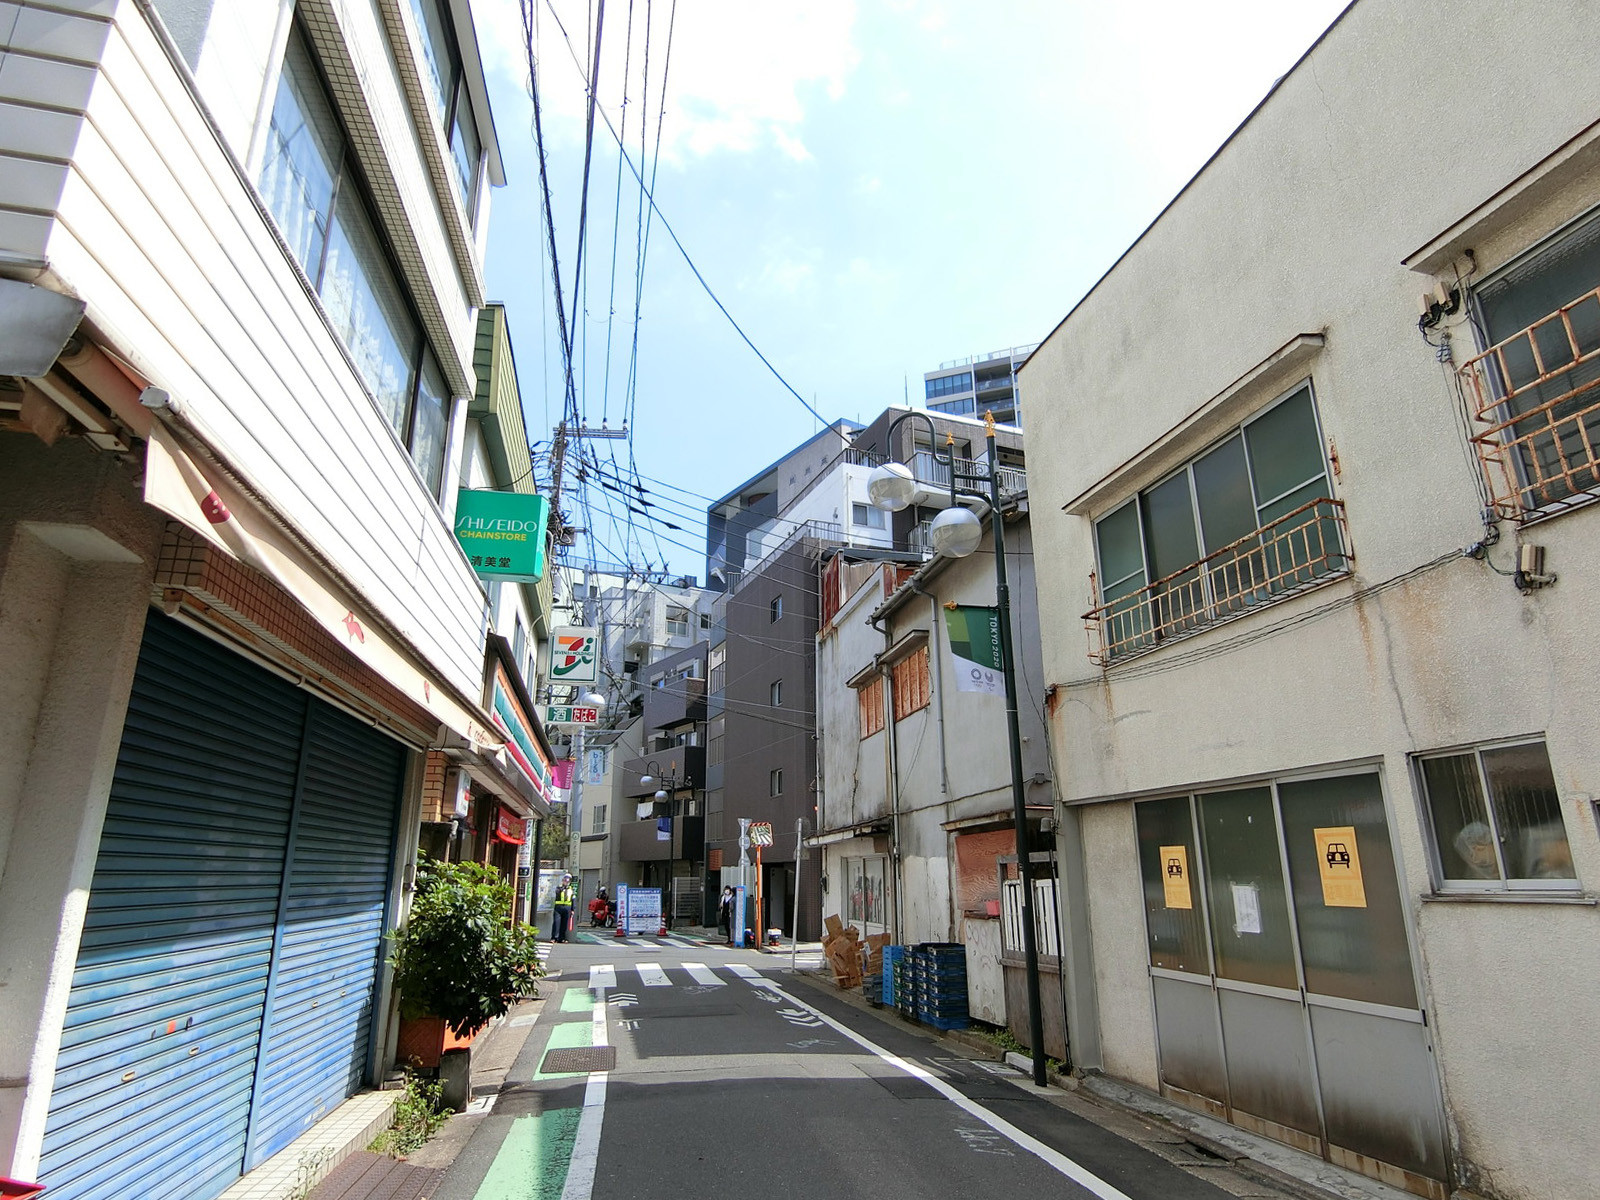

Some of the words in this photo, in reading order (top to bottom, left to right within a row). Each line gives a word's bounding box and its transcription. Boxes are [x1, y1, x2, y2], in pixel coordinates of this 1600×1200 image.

[455, 515, 537, 532] SHISEIDO
[459, 530, 527, 542] CHAINSTORE
[470, 555, 511, 568] 清美堂
[989, 616, 998, 645] TOKYO
[552, 706, 568, 722] 酒
[573, 708, 596, 722] たばこ
